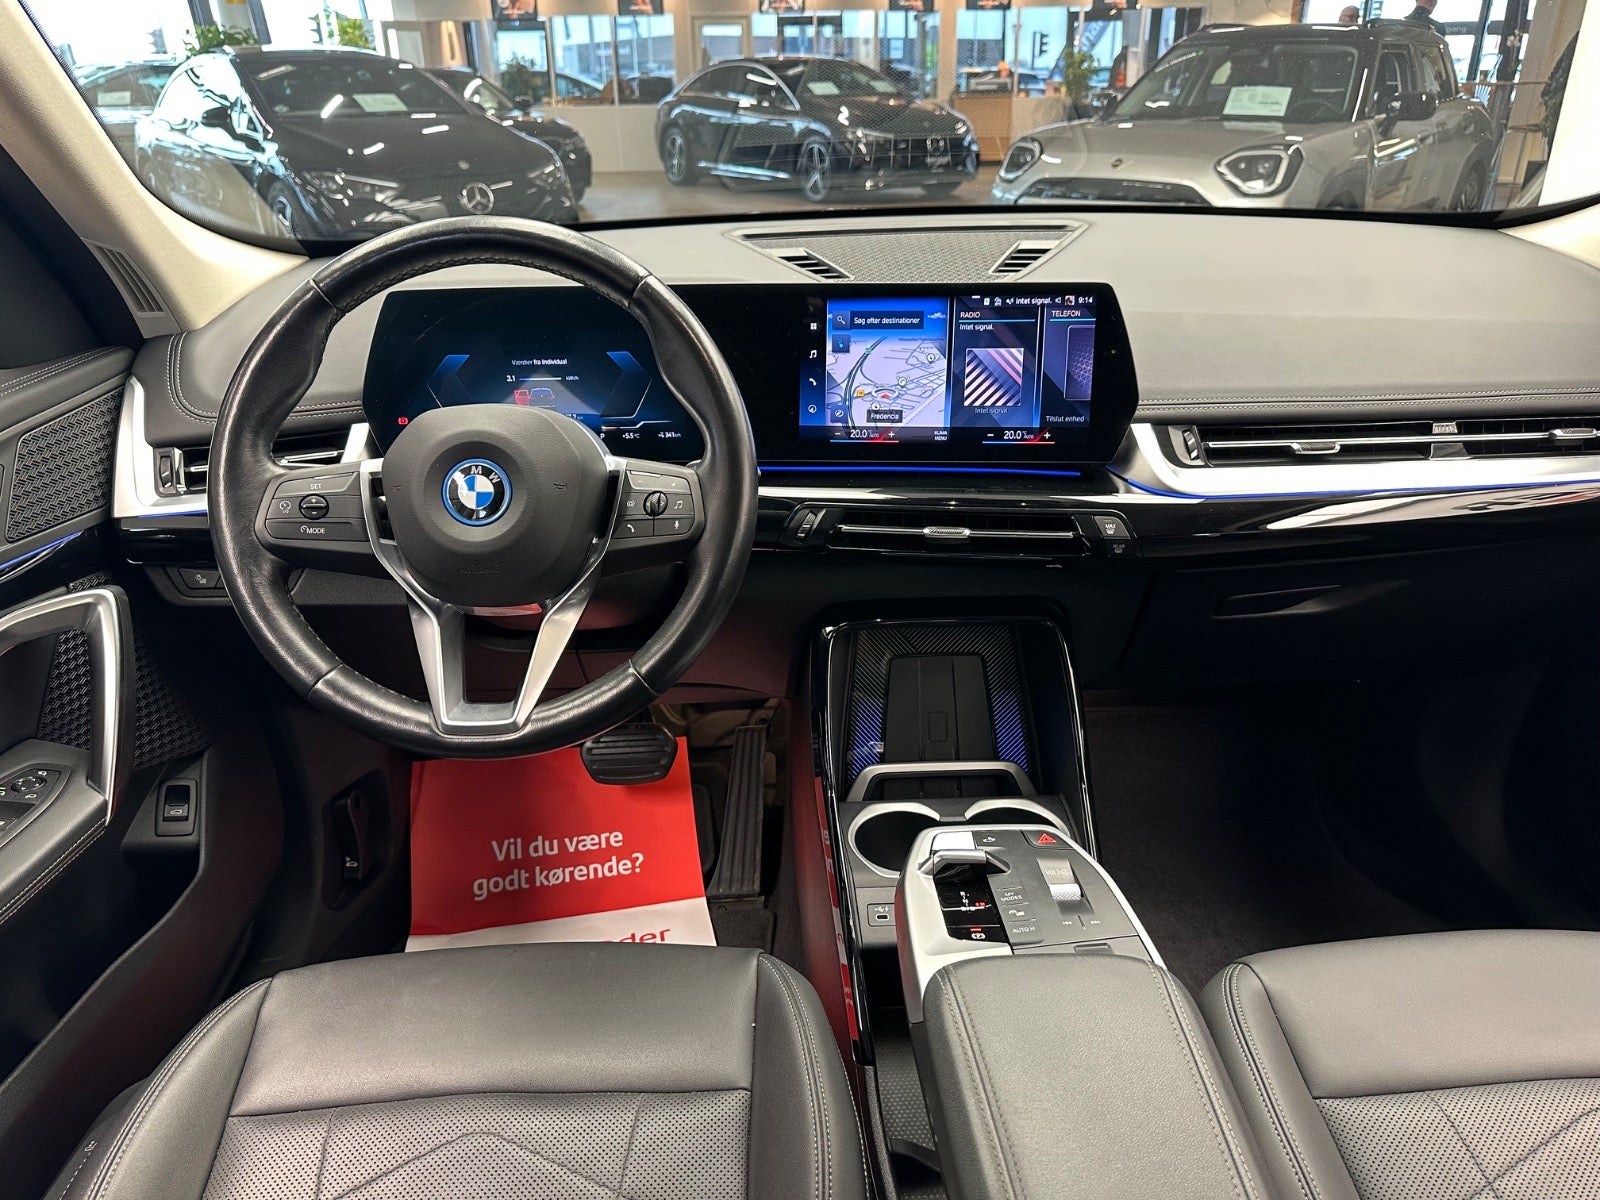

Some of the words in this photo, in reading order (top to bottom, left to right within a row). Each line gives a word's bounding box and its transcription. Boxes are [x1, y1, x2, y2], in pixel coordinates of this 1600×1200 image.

[1031, 297, 1052, 305] signal.
[1078, 296, 1093, 304] 9:14
[850, 429, 868, 438] 20.0
[1003, 430, 1022, 440] 20.0
[454, 465, 501, 484] MW
[491, 836, 523, 862] Vil
[529, 835, 559, 858] du
[564, 831, 624, 853] være
[473, 868, 530, 901] godt
[535, 852, 644, 887] kørende?
